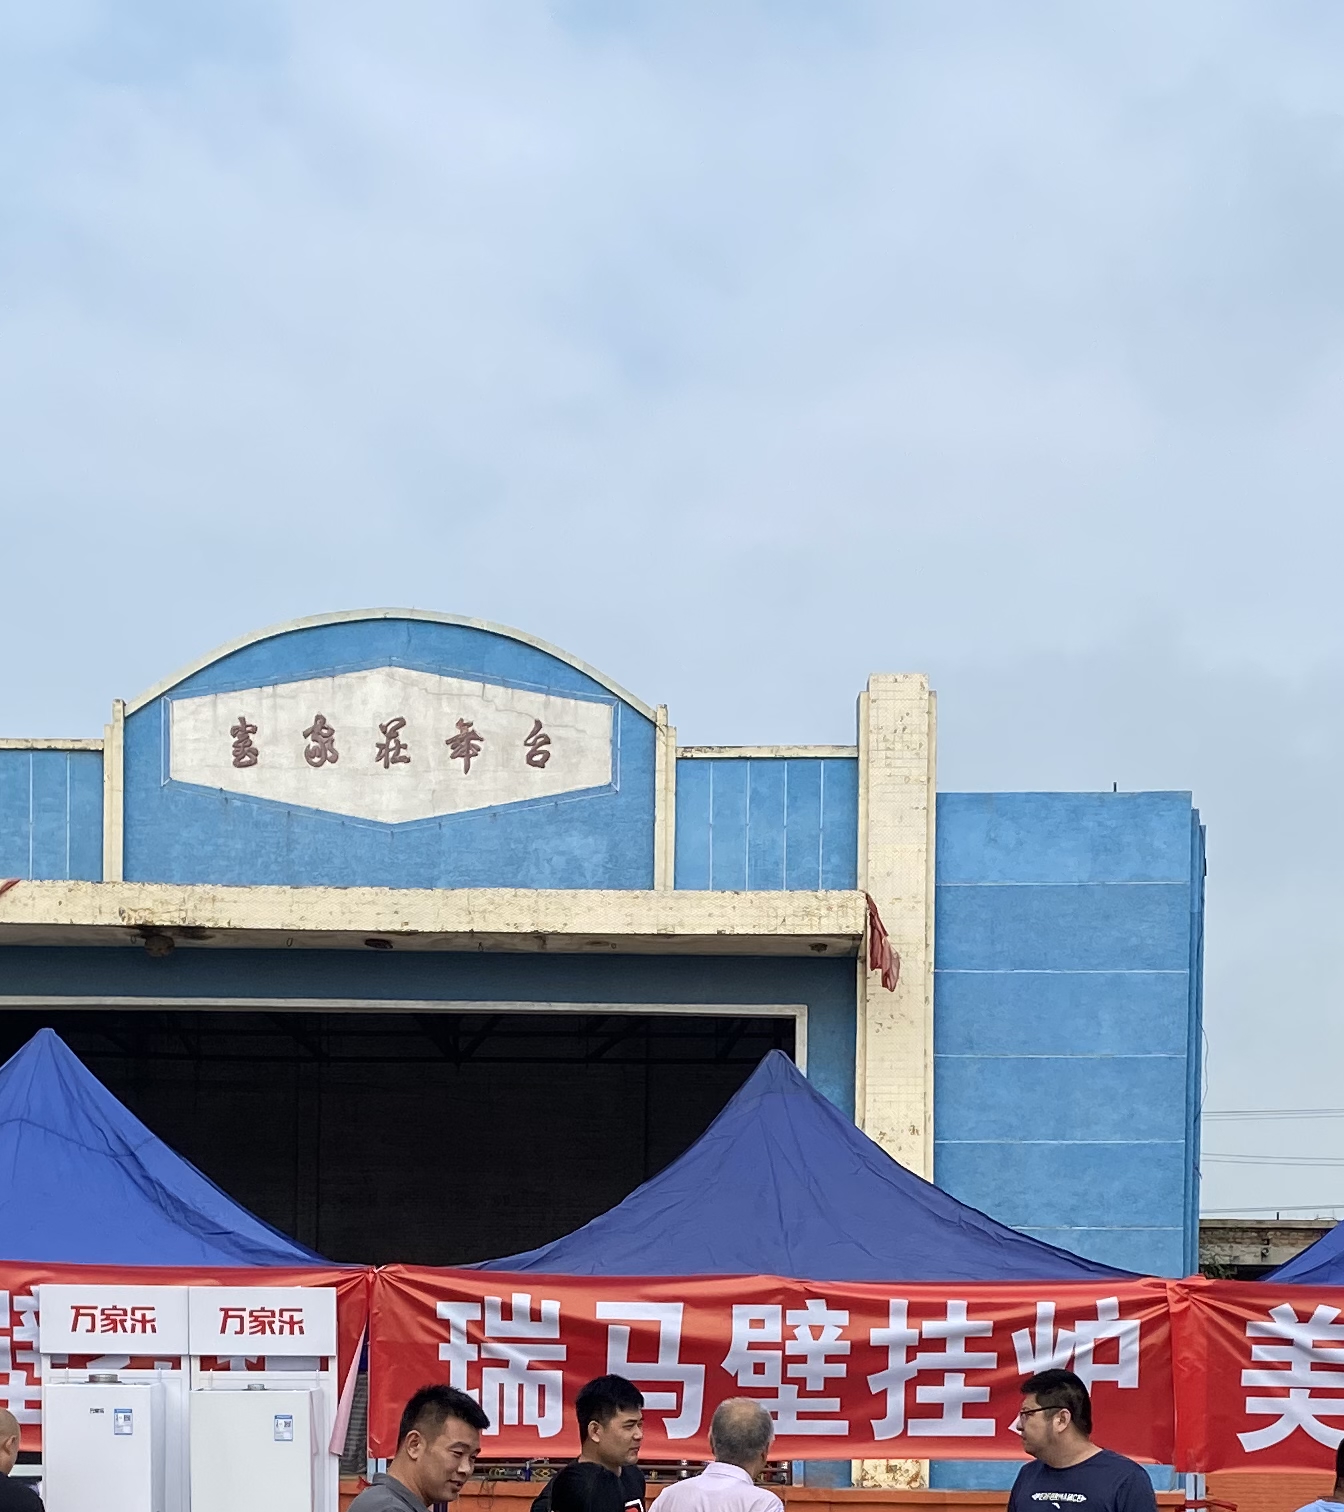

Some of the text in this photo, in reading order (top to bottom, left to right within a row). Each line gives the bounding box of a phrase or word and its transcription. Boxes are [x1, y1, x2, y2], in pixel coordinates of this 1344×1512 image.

[70, 1304, 157, 1334] 万家乐
[219, 1306, 305, 1335] 万家乐
